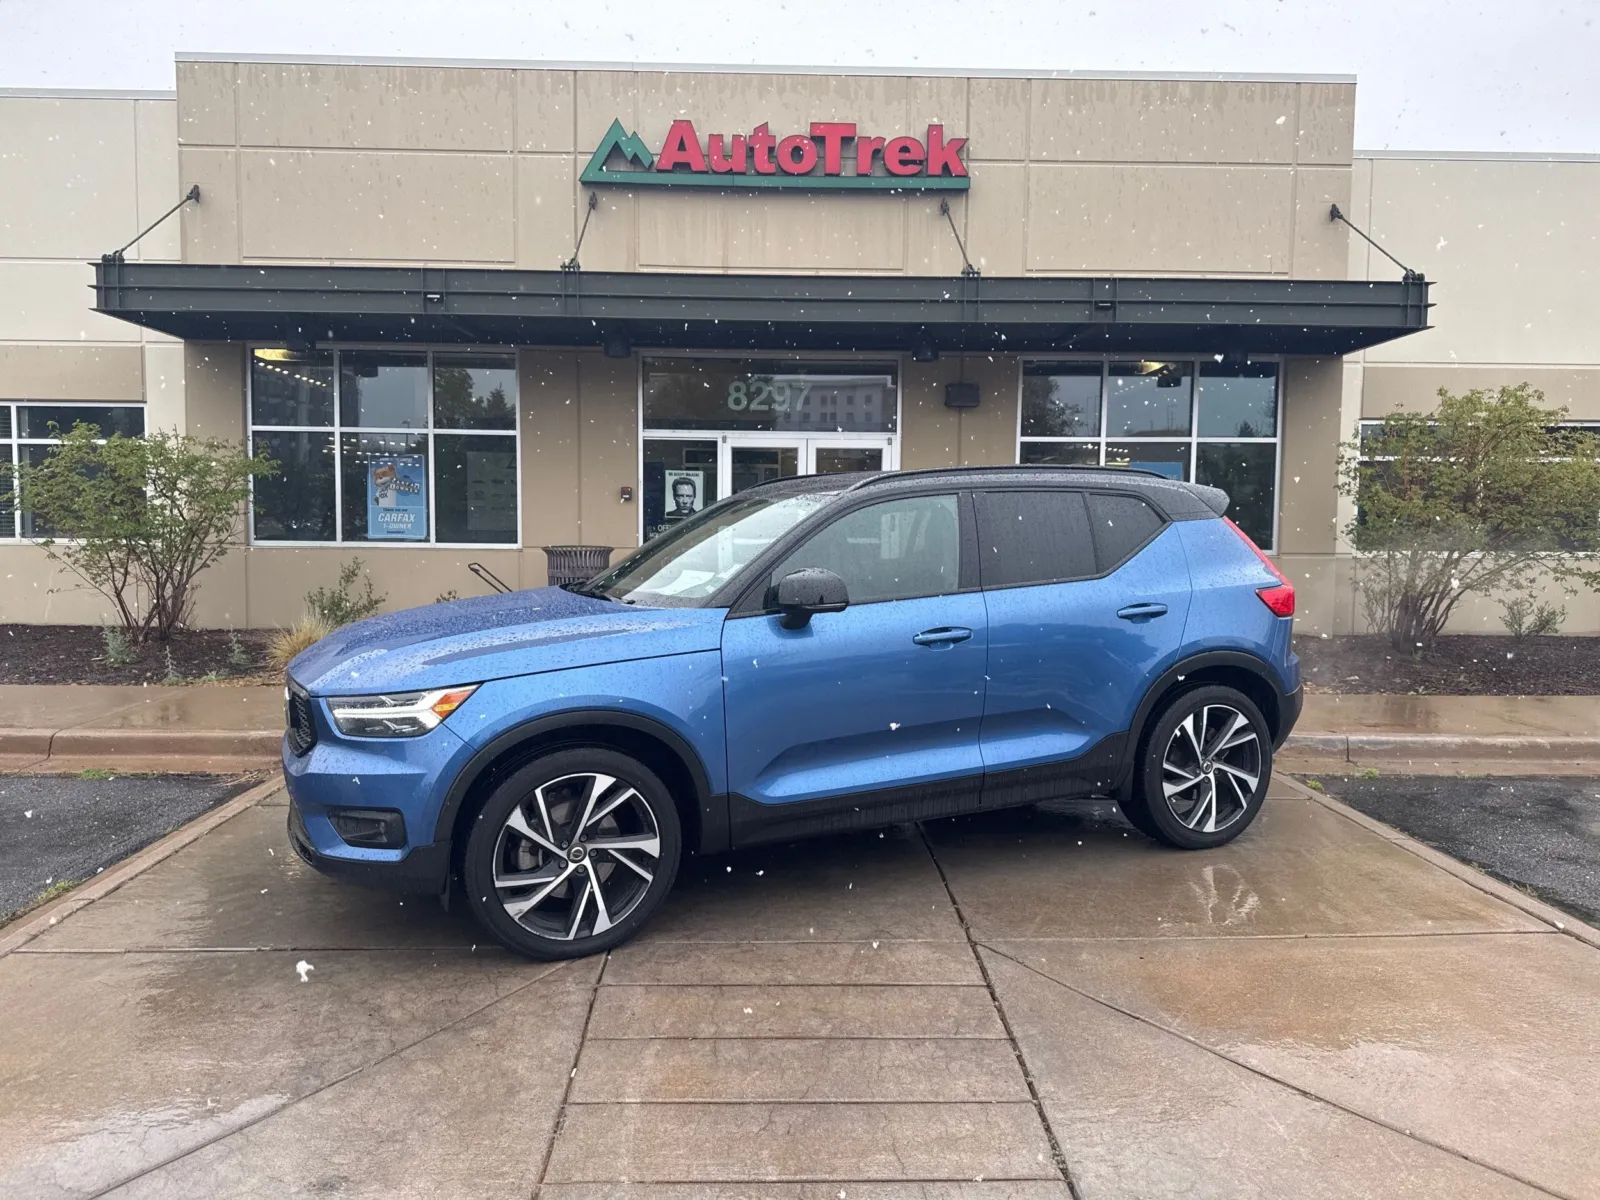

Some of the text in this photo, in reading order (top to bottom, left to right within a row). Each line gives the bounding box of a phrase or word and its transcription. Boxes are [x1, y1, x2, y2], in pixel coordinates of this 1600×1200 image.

[655, 119, 970, 177] AutoTrek
[727, 380, 813, 412] 8297
[378, 512, 416, 523] CARFAX
